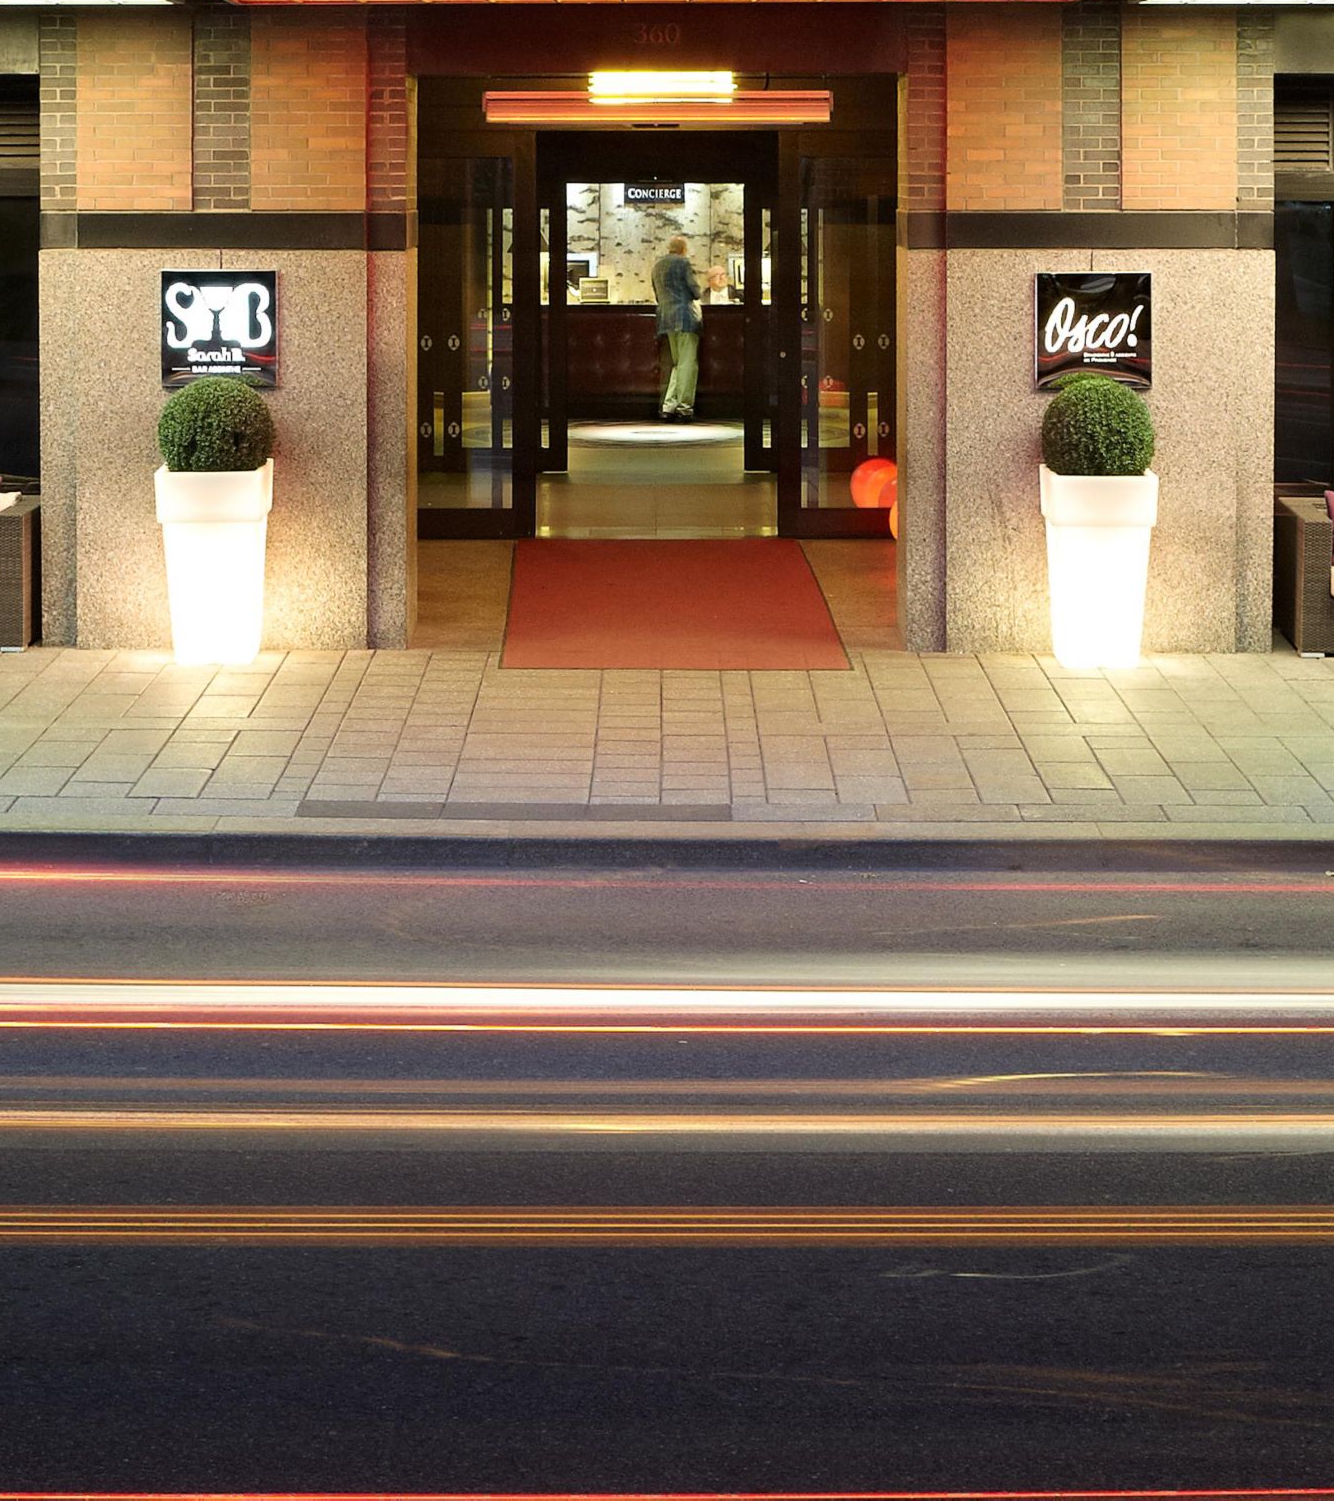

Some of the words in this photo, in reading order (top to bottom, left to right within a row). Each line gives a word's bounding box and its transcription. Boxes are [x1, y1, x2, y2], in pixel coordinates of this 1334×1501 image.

[634, 22, 680, 43] 360
[627, 187, 682, 199] CONCIERGE
[1044, 296, 1145, 353] Osco!
